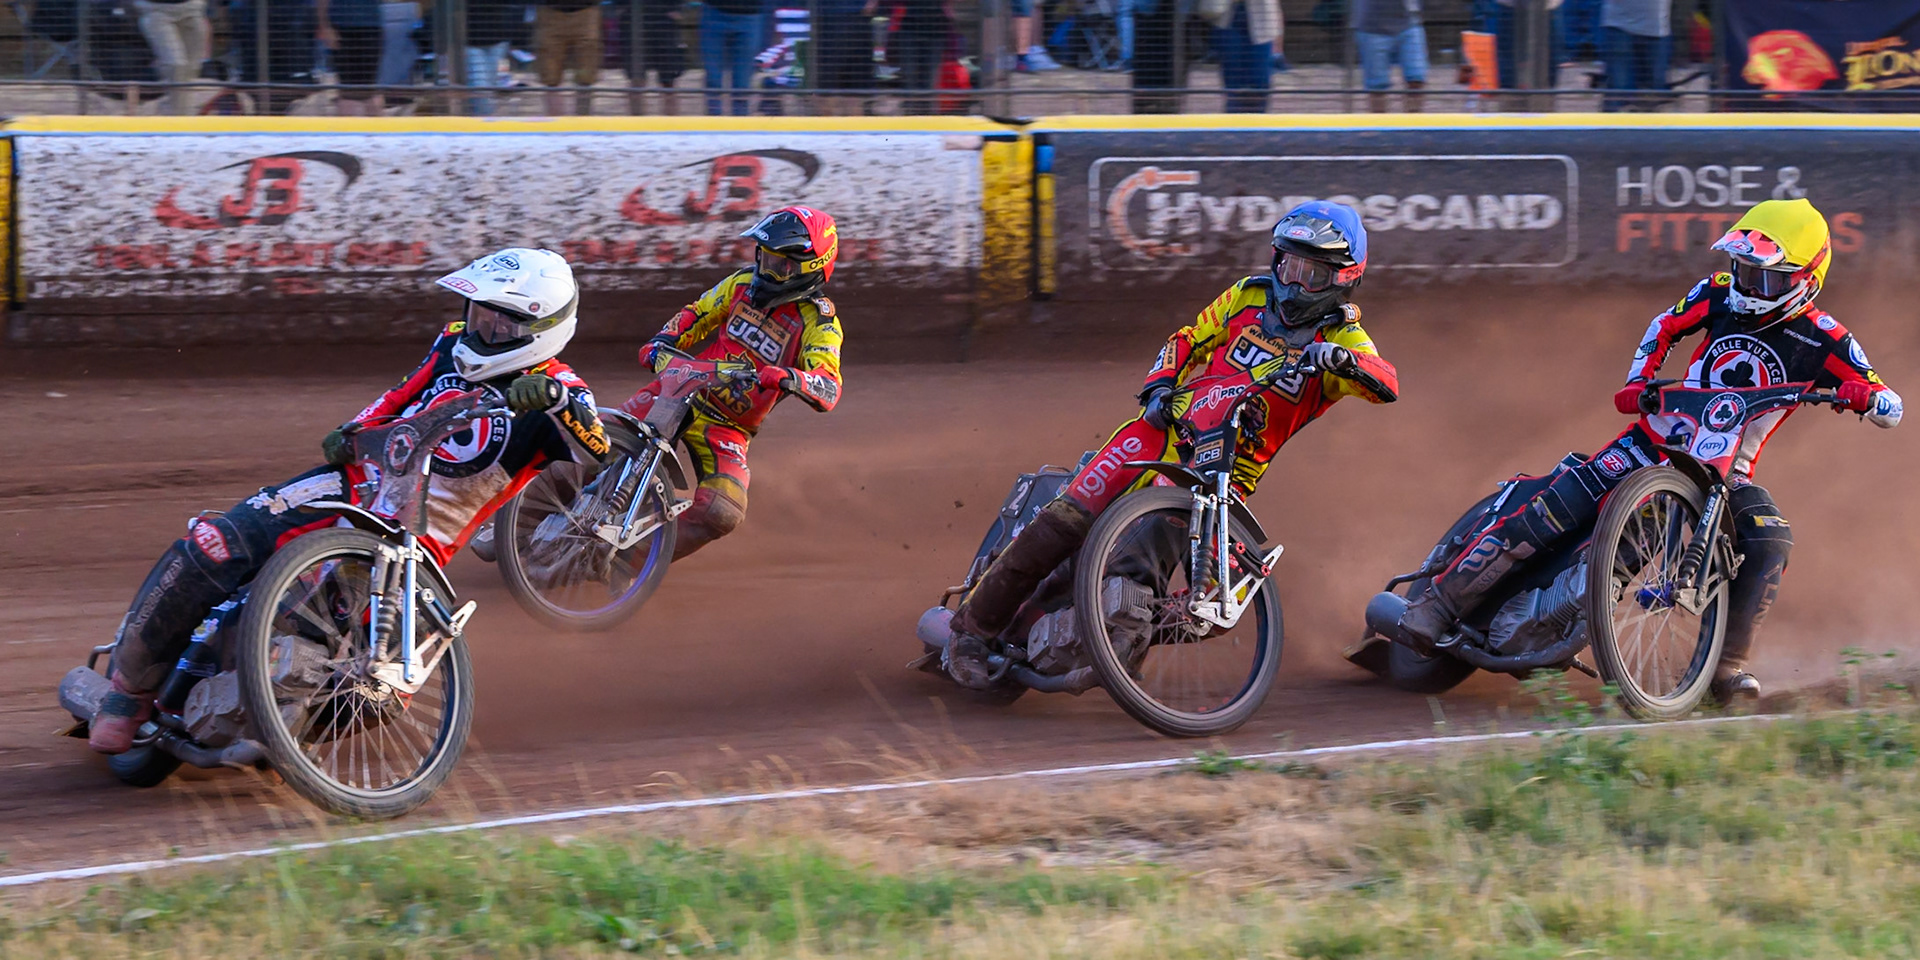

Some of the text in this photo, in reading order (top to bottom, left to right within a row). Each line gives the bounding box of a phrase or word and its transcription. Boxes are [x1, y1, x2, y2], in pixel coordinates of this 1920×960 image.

[1616, 165, 1808, 207] HOSE &
[1616, 213, 1866, 252] FITTS
[728, 320, 781, 363] JCB
[1711, 340, 1782, 384] BELLE VUE ACE
[430, 379, 467, 395] BELLE
[1221, 386, 1245, 399] PRO
[492, 414, 505, 442] CES
[1195, 448, 1221, 465] JCB
[1701, 442, 1722, 450] ATPI
[1077, 437, 1142, 498] ignite
[1009, 481, 1029, 510] 2
[1702, 497, 1717, 525] FALCON
